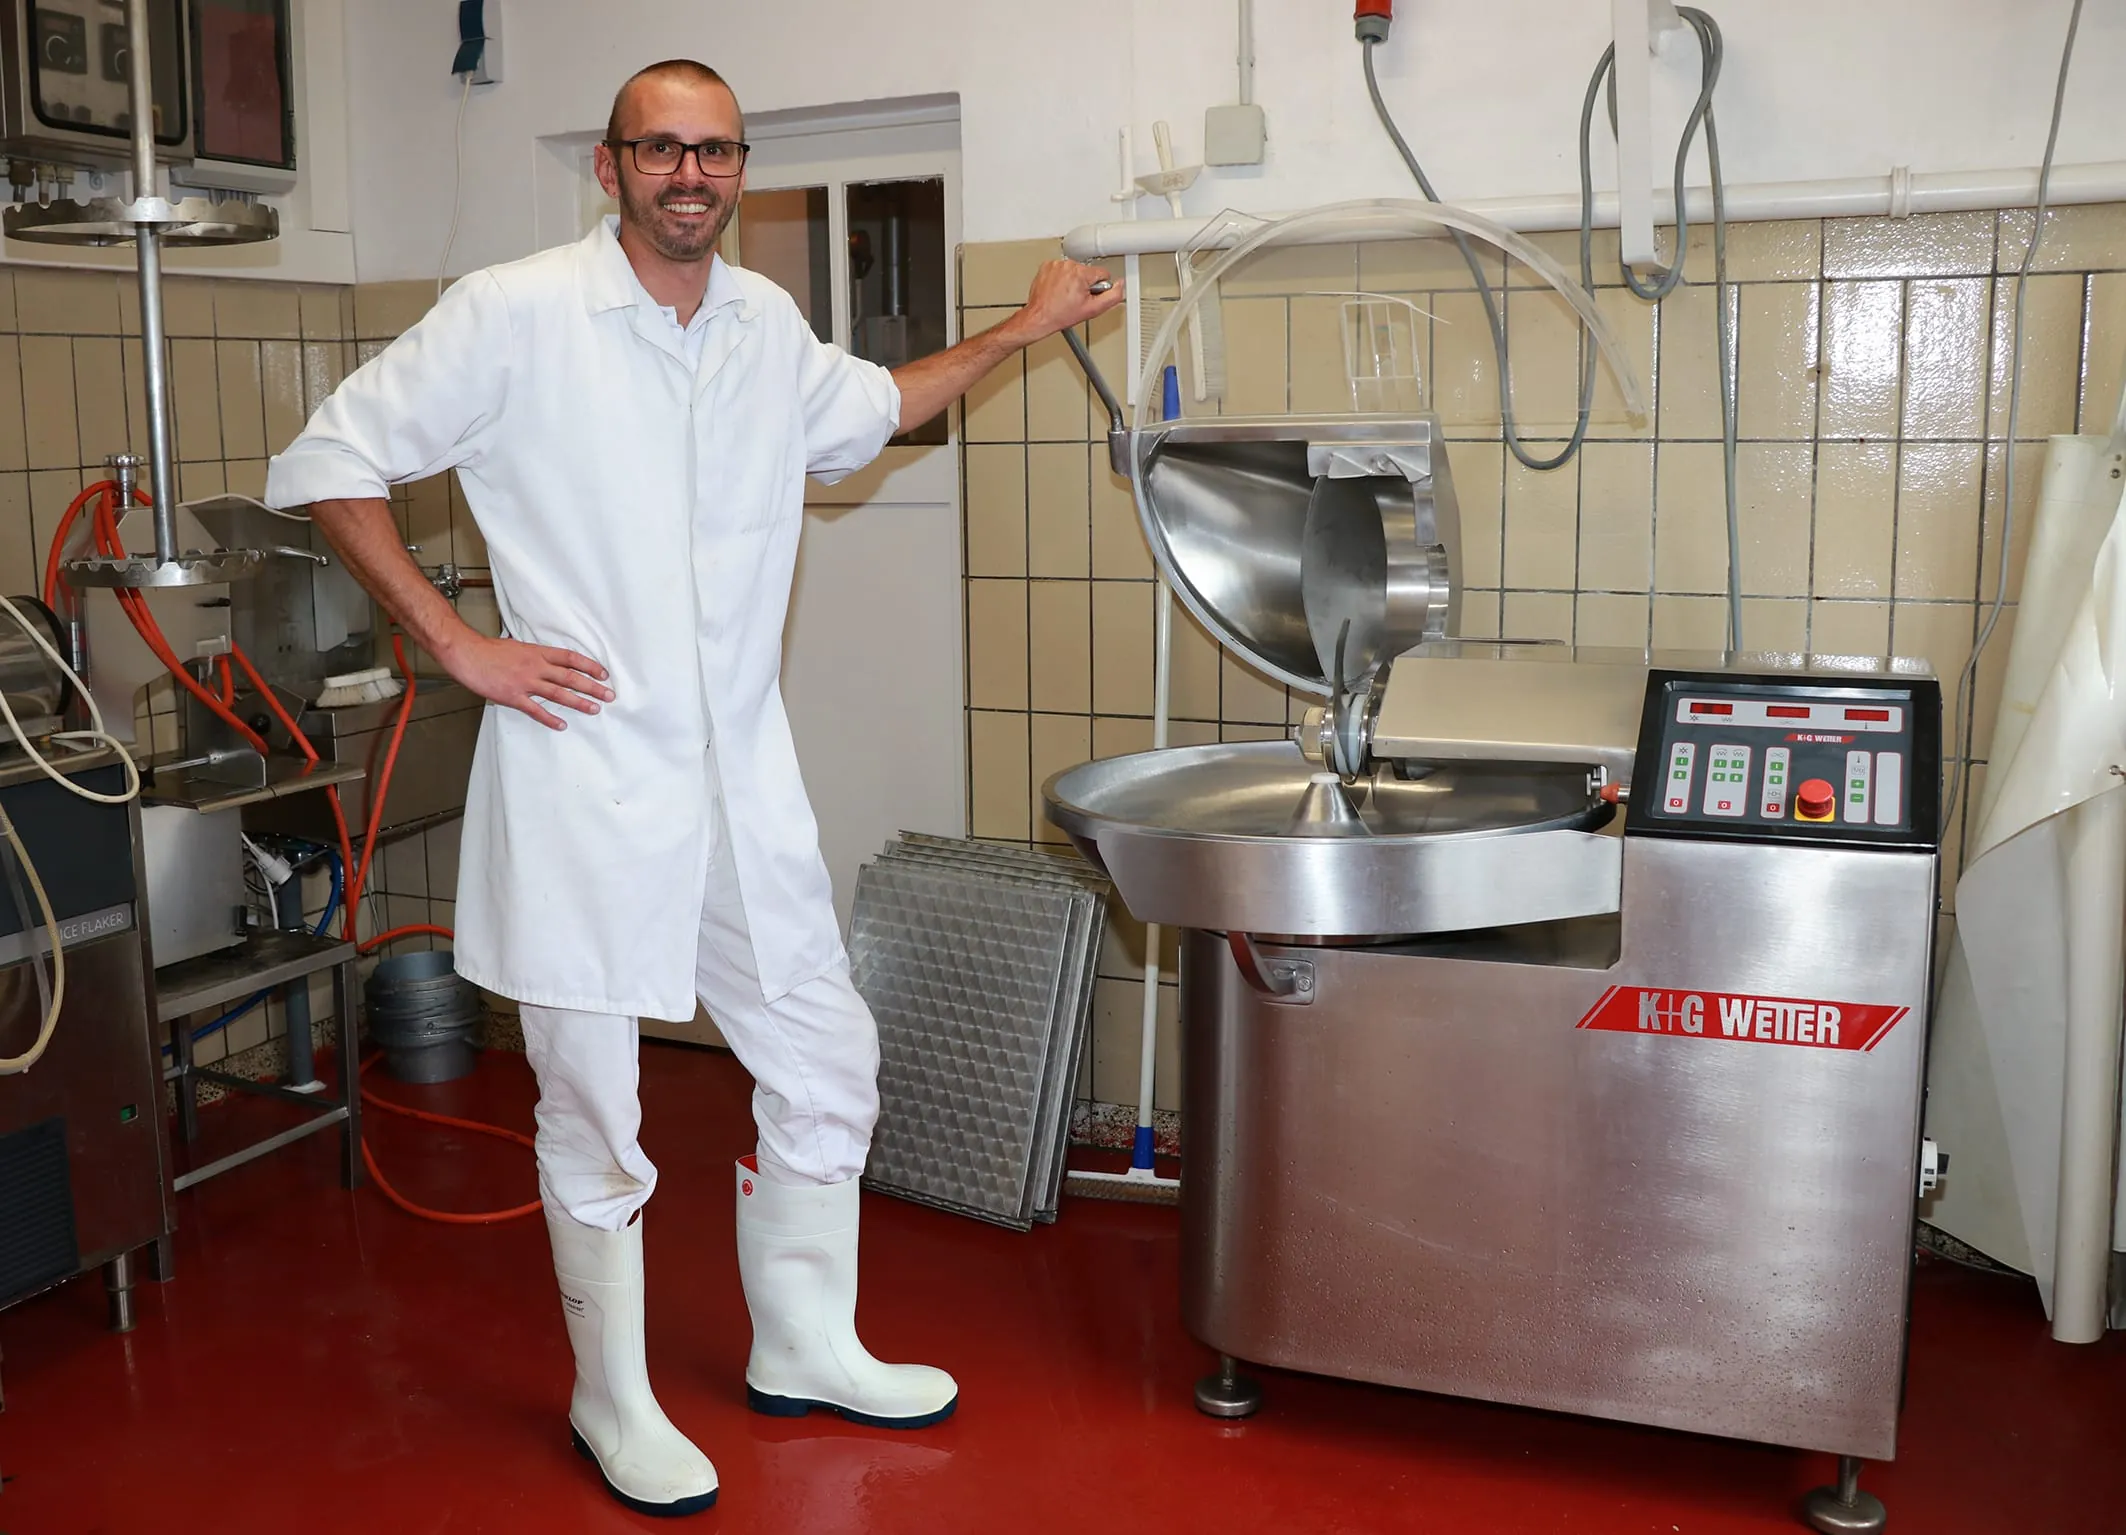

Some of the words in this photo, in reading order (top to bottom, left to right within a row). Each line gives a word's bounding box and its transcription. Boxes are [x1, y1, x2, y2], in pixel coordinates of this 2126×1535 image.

[60, 924, 79, 940] ICE
[81, 912, 124, 935] FLAKER
[1718, 997, 1841, 1045] WETTER
